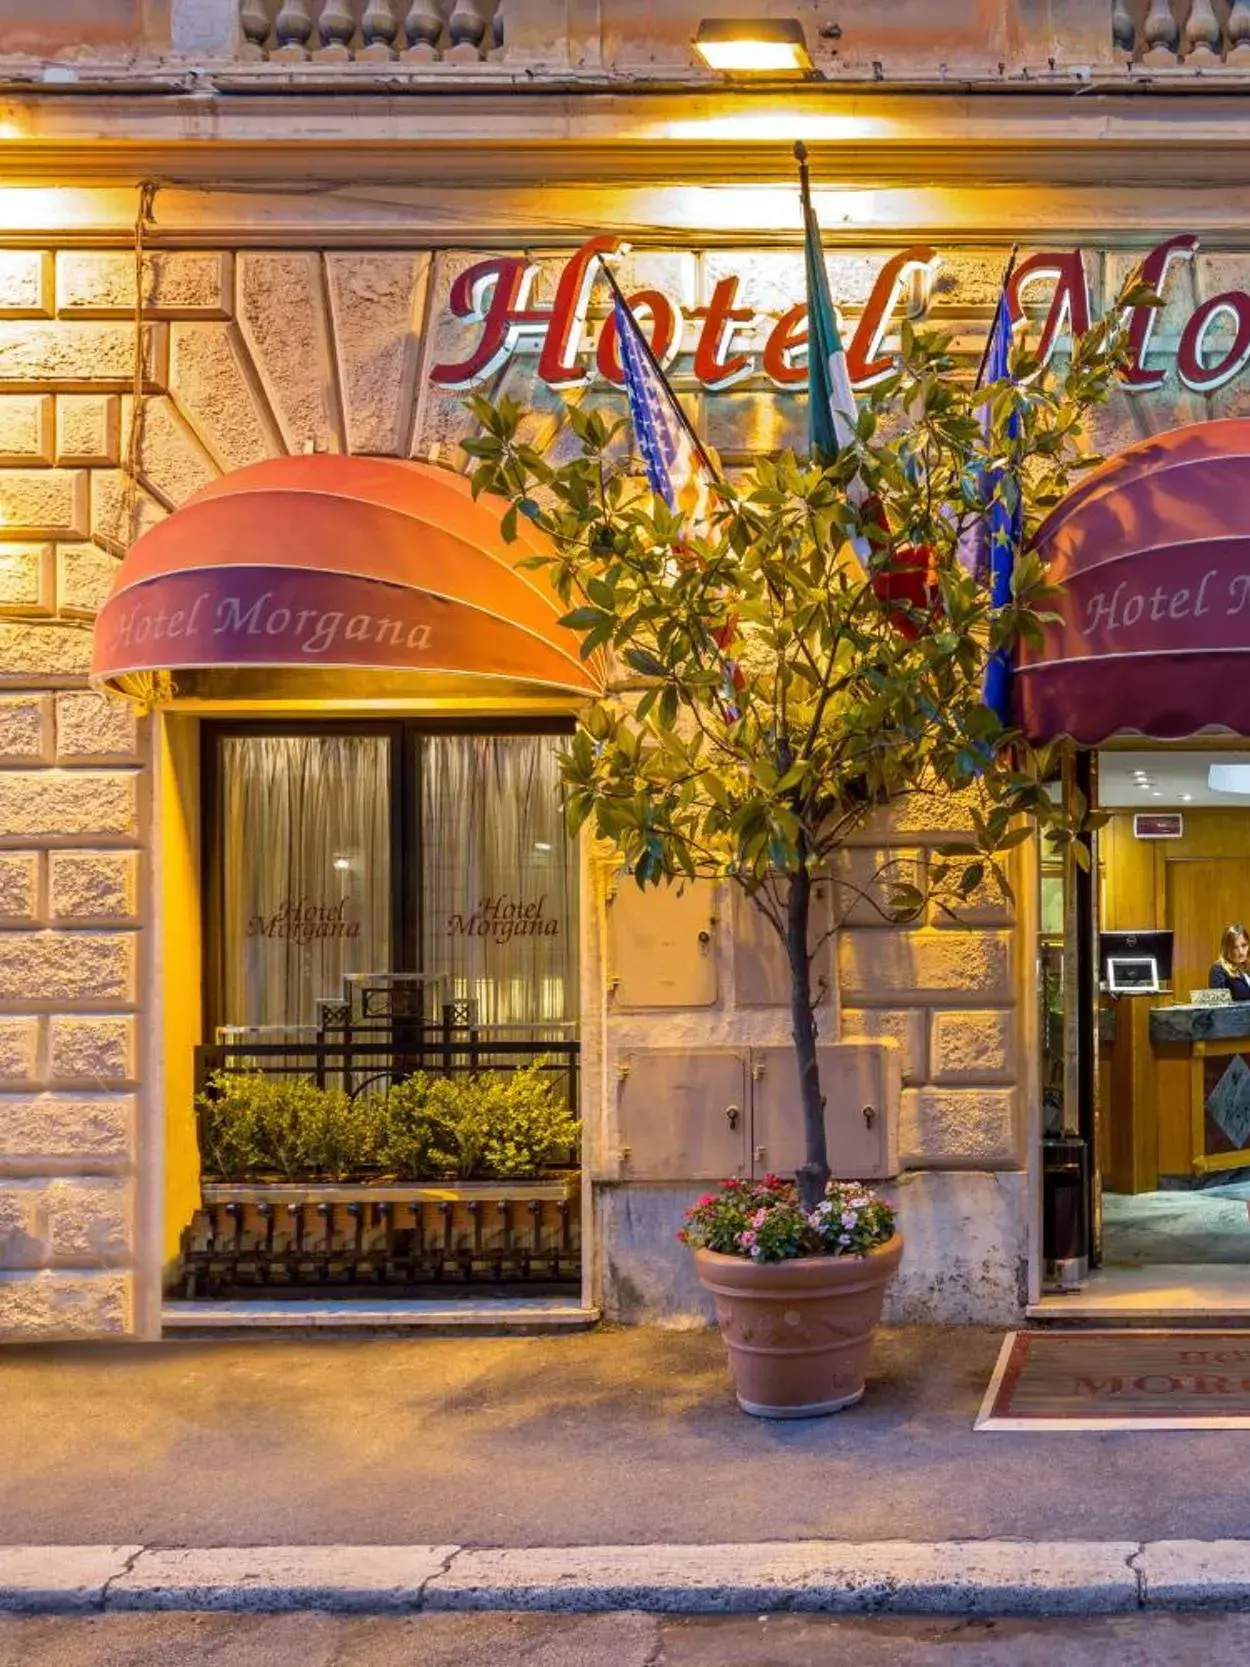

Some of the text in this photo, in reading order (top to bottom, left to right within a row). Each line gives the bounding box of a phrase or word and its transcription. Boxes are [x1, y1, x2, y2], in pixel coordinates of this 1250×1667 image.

[430, 234, 937, 389] Hotel
[1083, 569, 1217, 635] Hotel
[110, 592, 433, 653] Hotel Morgana
[279, 896, 351, 922] Hotel
[476, 893, 548, 920] Hotel
[248, 914, 361, 945] Morgana
[446, 914, 560, 944] Morgana
